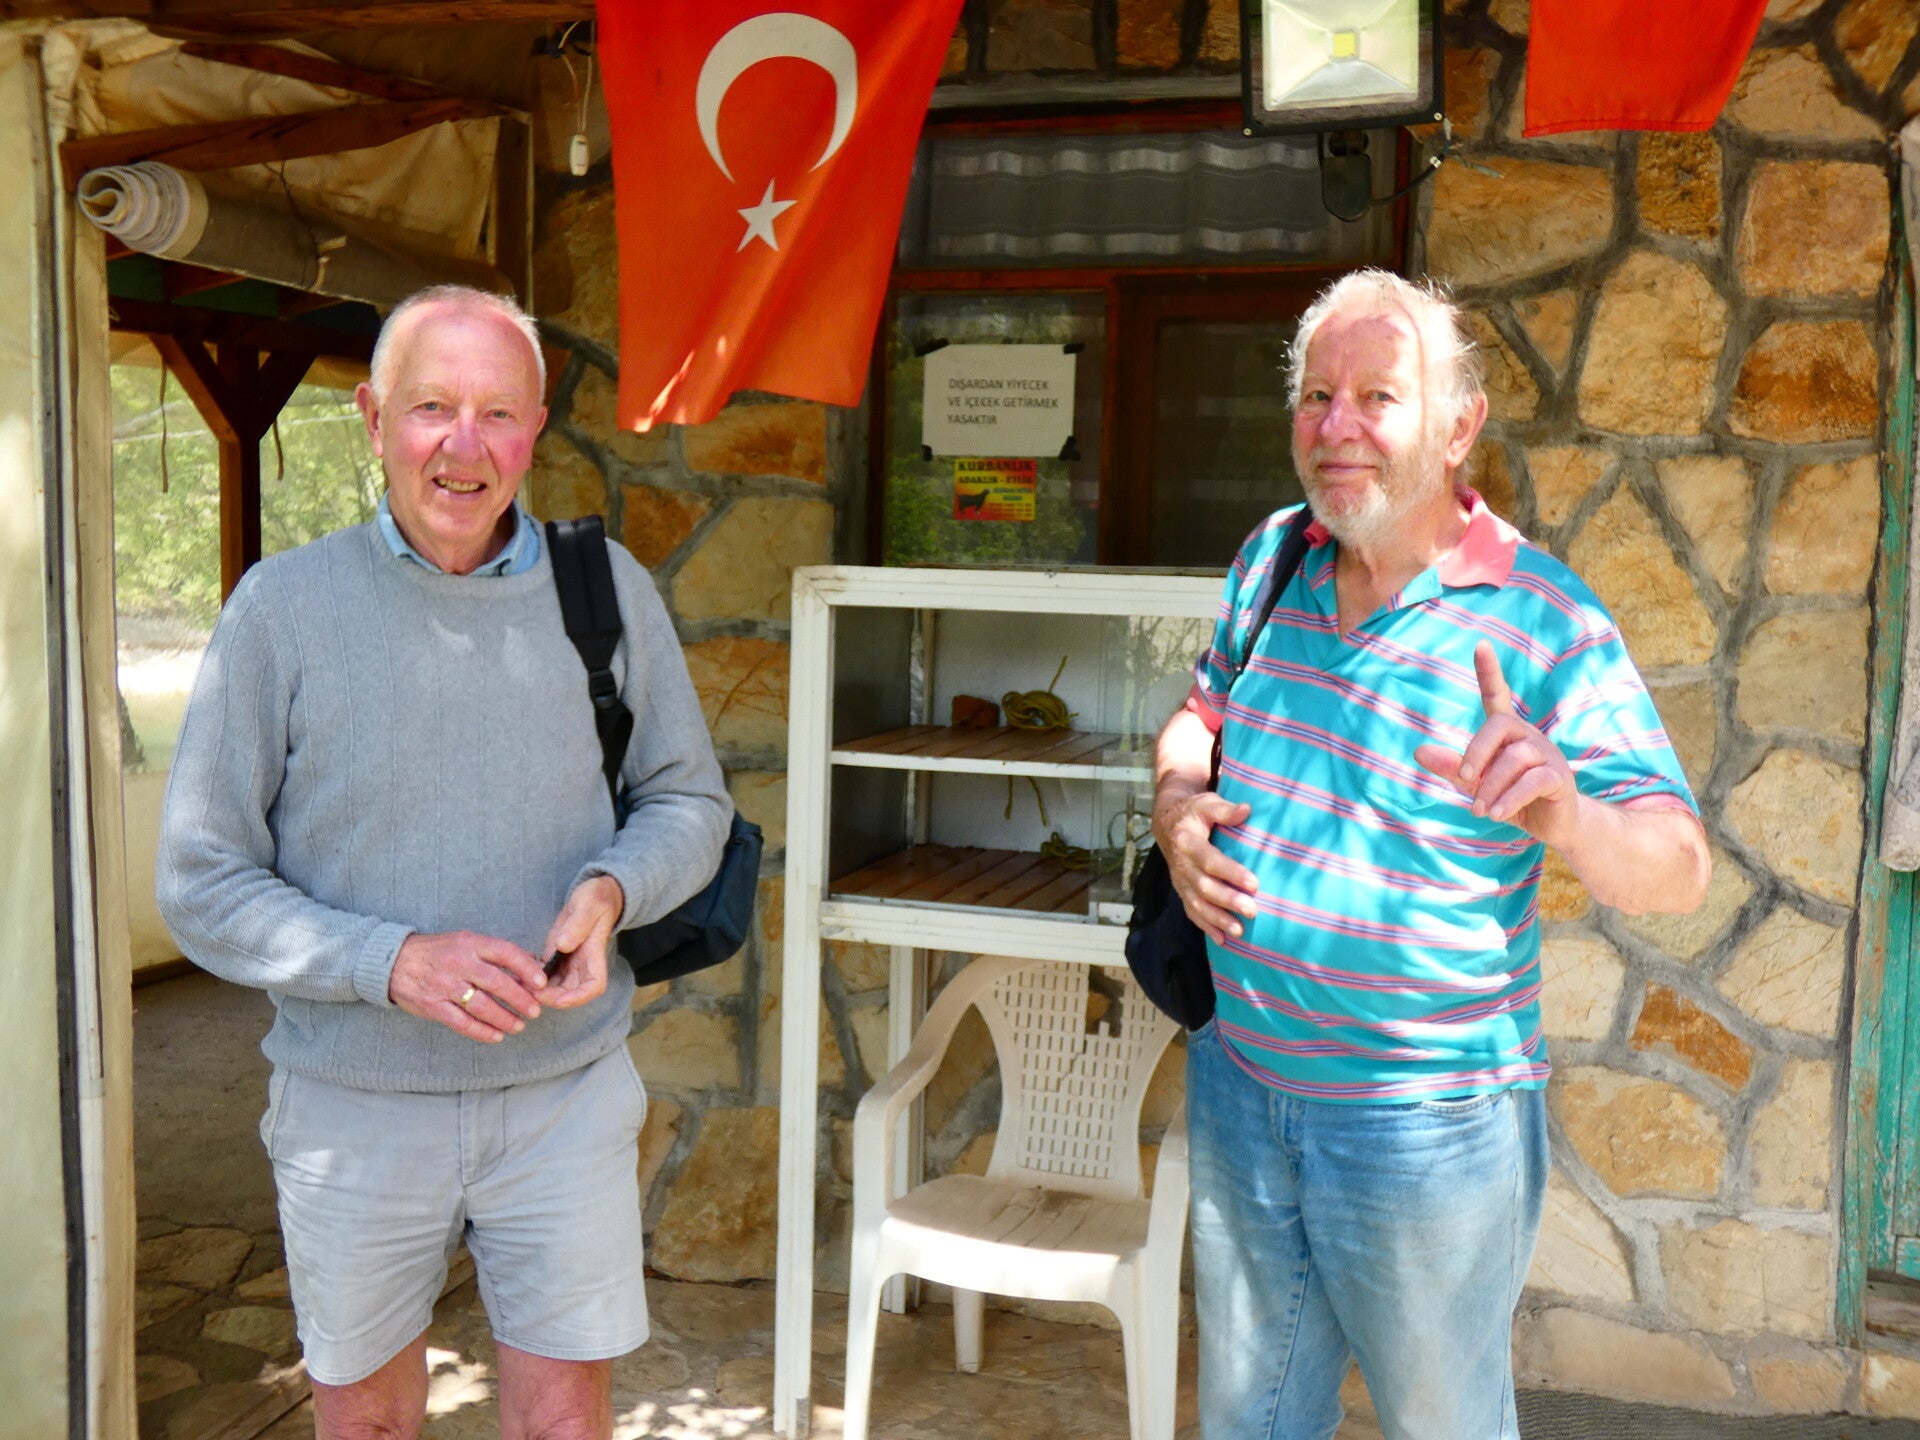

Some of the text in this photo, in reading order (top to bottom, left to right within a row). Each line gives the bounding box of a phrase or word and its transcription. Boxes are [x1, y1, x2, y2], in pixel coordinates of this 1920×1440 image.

[948, 378, 1049, 391] DIŞARDAN YİYECEK
[948, 396, 1059, 409] VE İÇECEK GETİRMEK
[947, 414, 997, 425] YASAKTIR
[959, 461, 1033, 471] KURBANLIK
